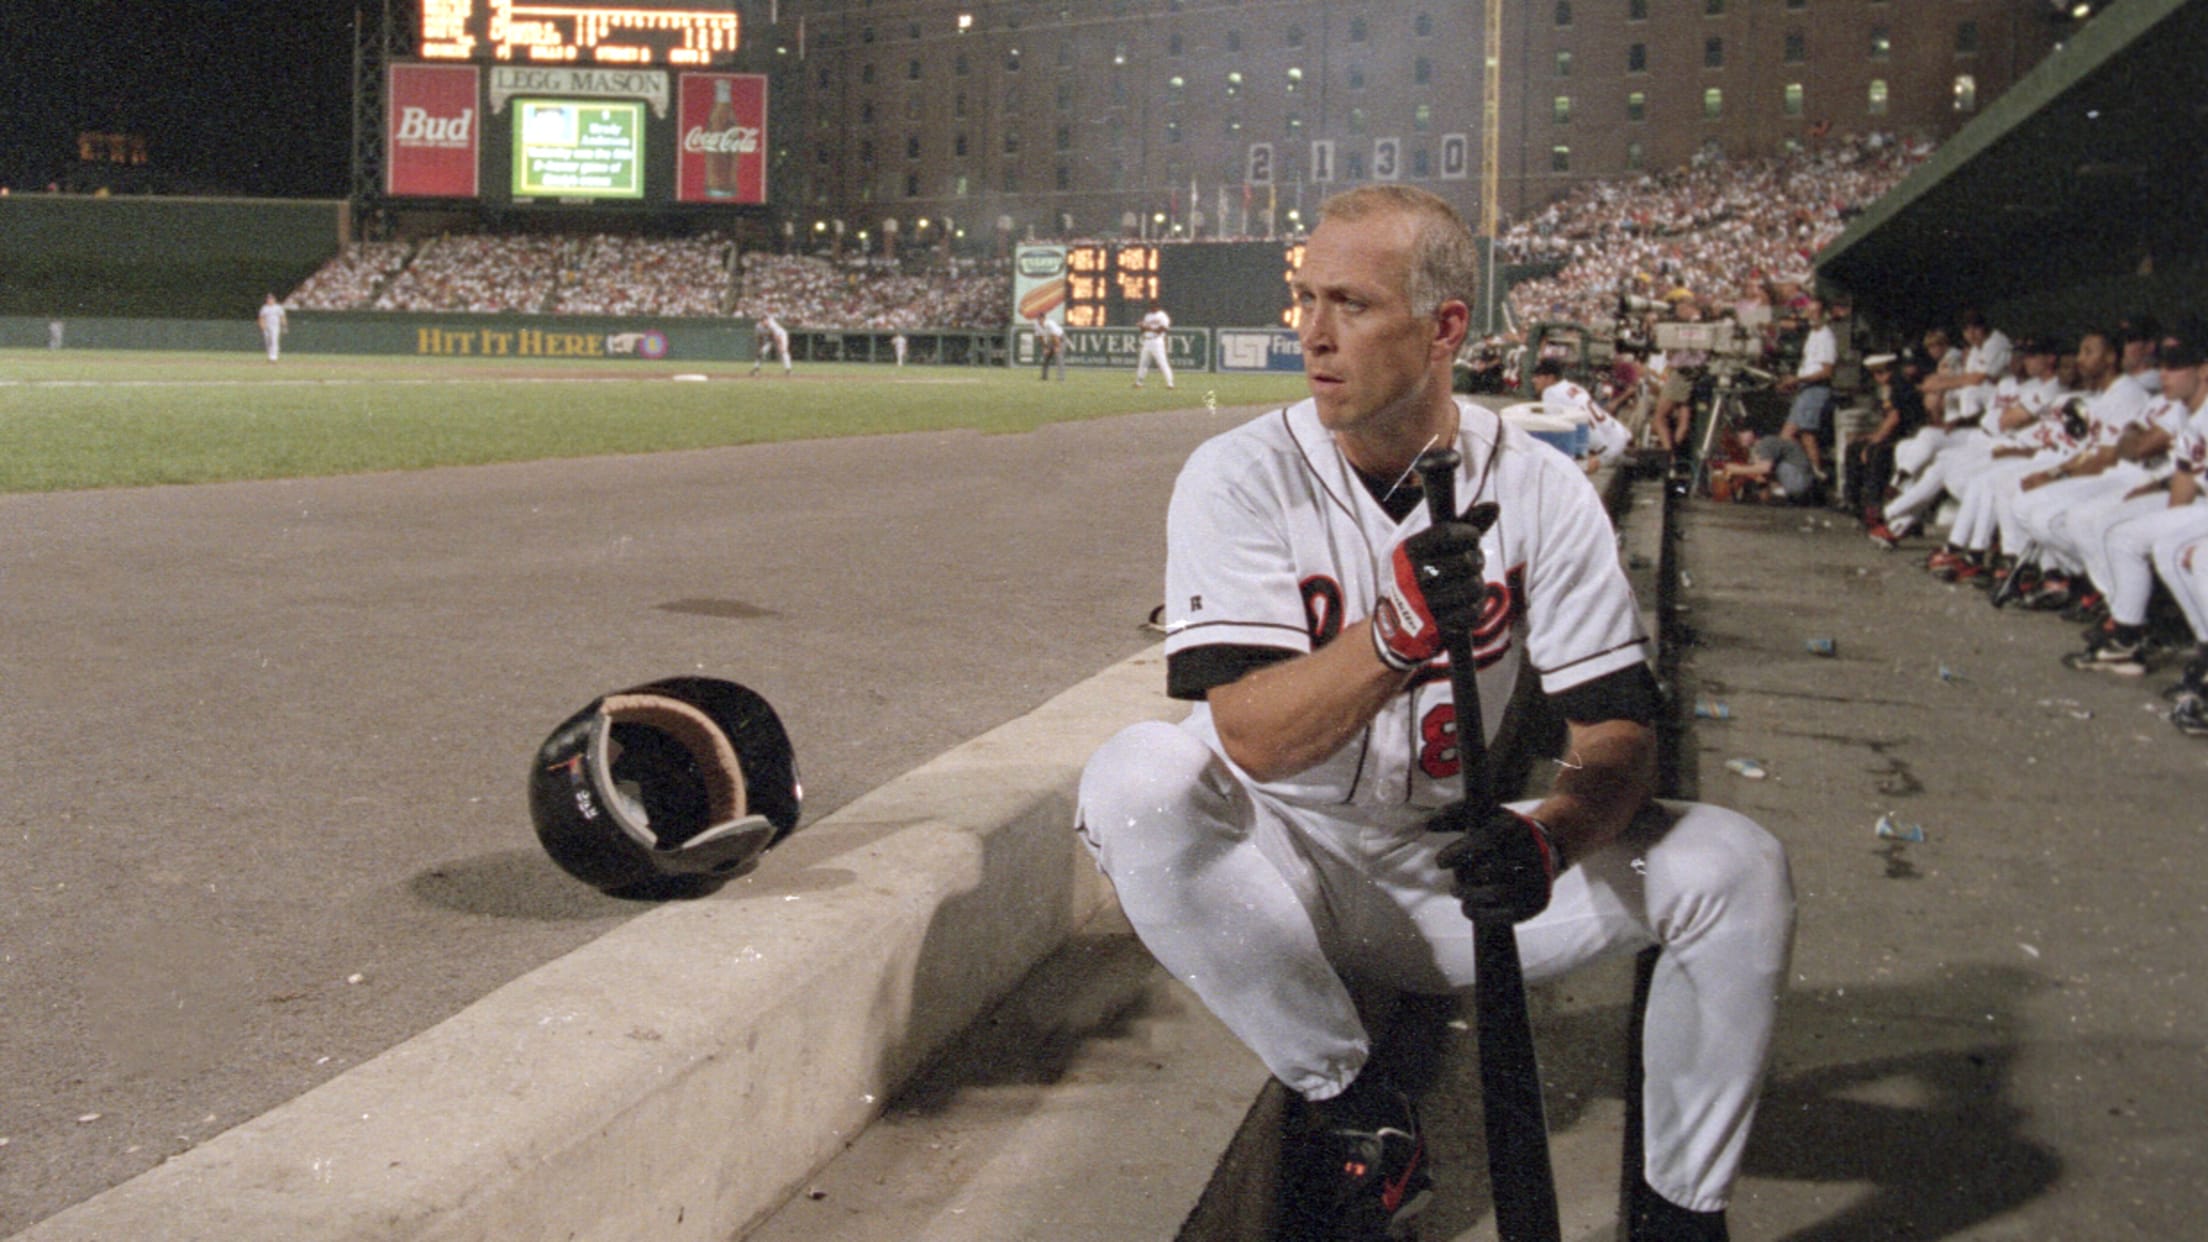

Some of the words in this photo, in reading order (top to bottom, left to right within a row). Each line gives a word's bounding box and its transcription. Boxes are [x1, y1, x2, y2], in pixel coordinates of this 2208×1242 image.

[497, 69, 561, 89] LEGG
[571, 72, 662, 93] MASON
[396, 106, 473, 140] Bud
[1252, 147, 1269, 180] 2
[1316, 144, 1329, 178] 1
[1377, 142, 1396, 175] 3
[1444, 138, 1464, 174] 0
[1420, 703, 1462, 779] 8
